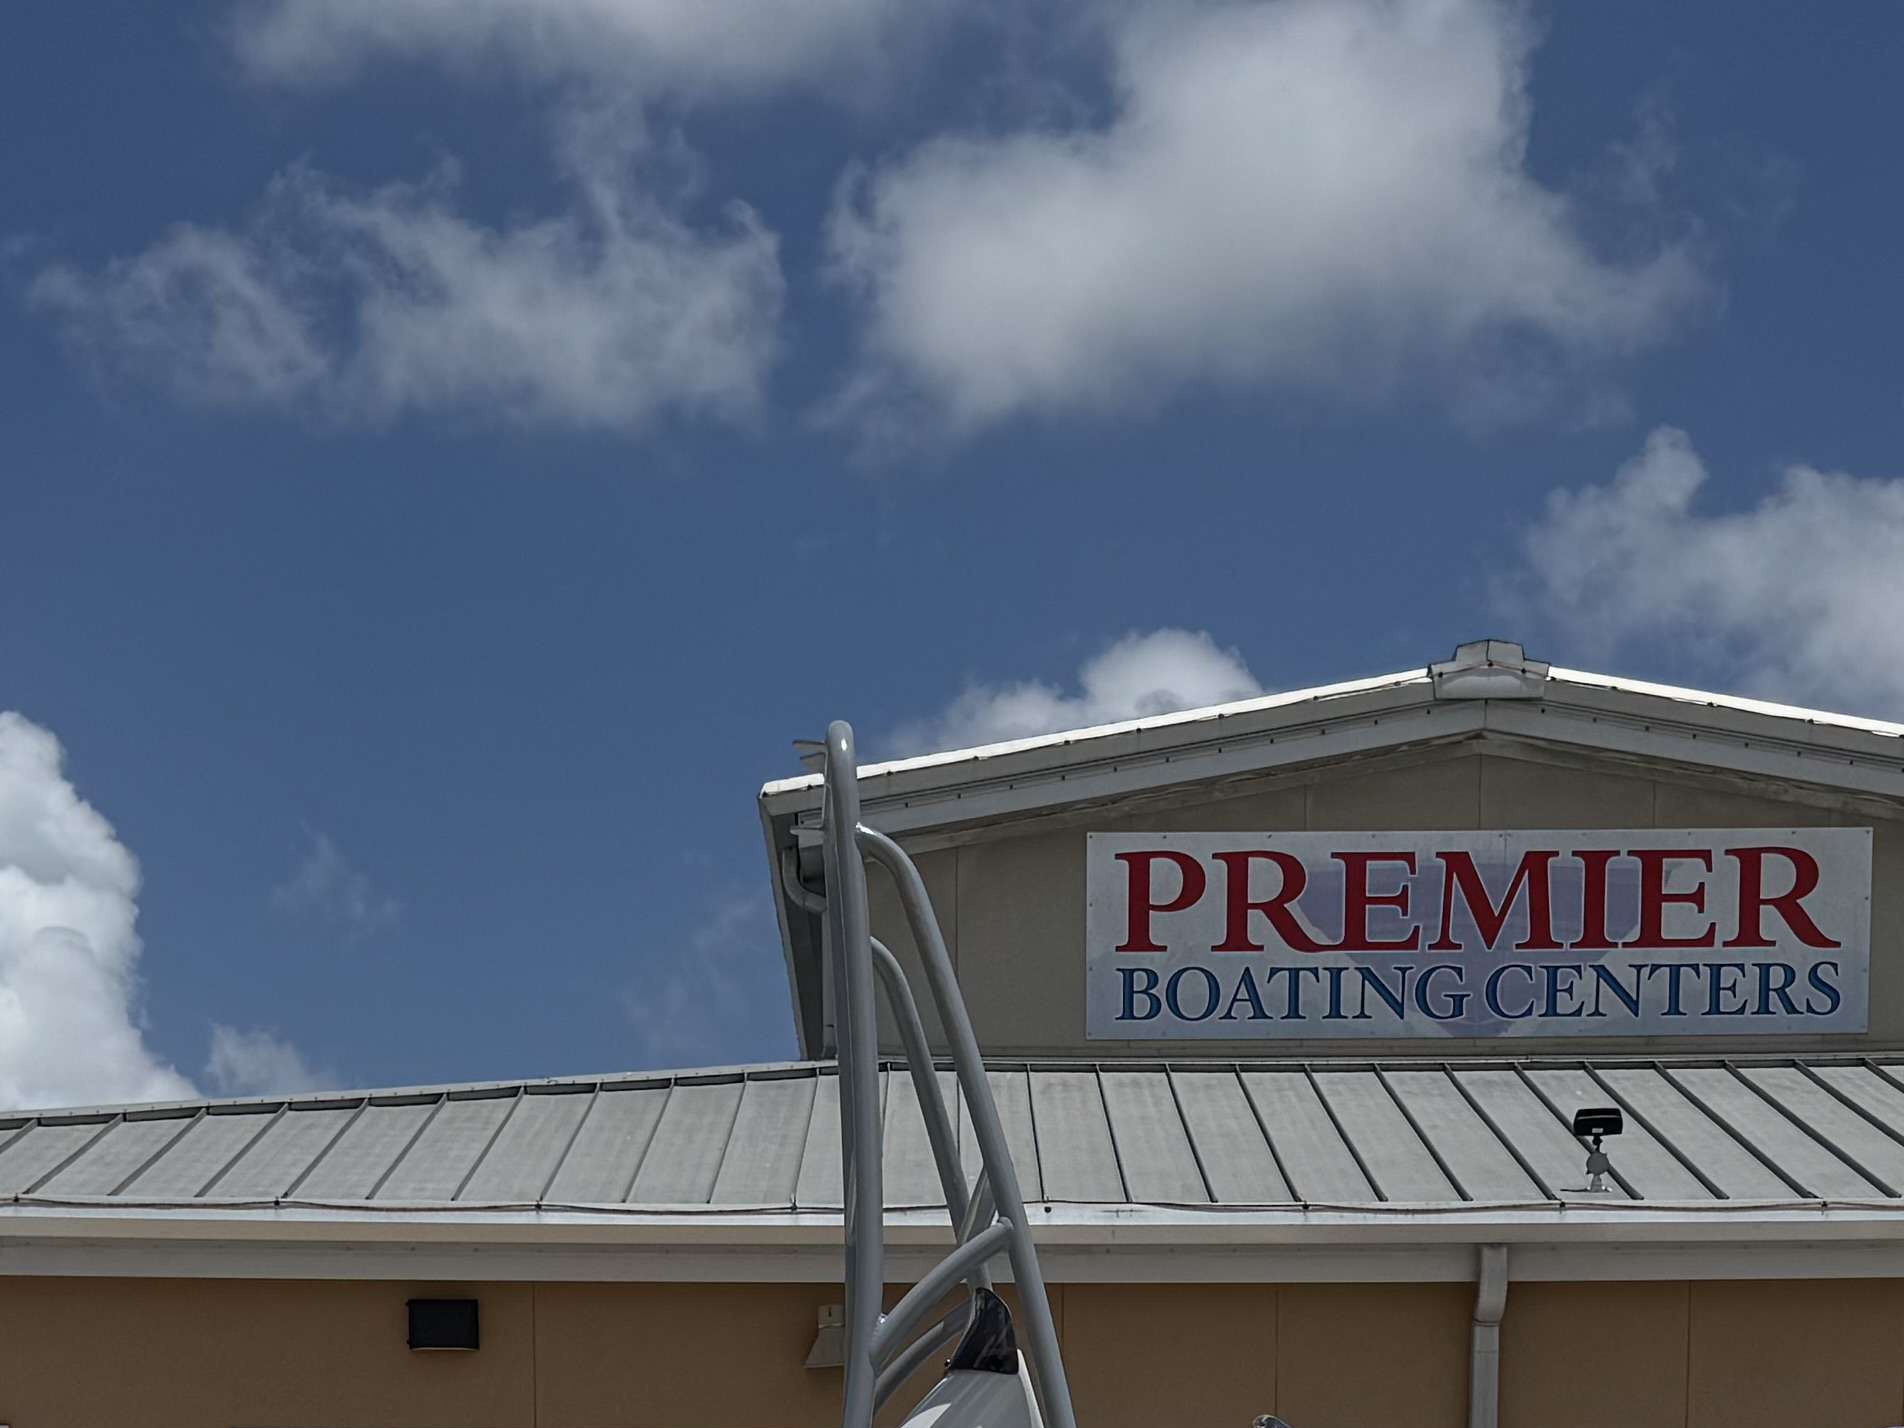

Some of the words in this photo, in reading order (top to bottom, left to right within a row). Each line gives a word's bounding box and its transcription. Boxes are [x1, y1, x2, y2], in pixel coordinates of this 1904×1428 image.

[1114, 846, 1842, 953] PREMIER
[1114, 966, 1471, 1022] BOATING
[1484, 960, 1842, 1019] CENTERS
